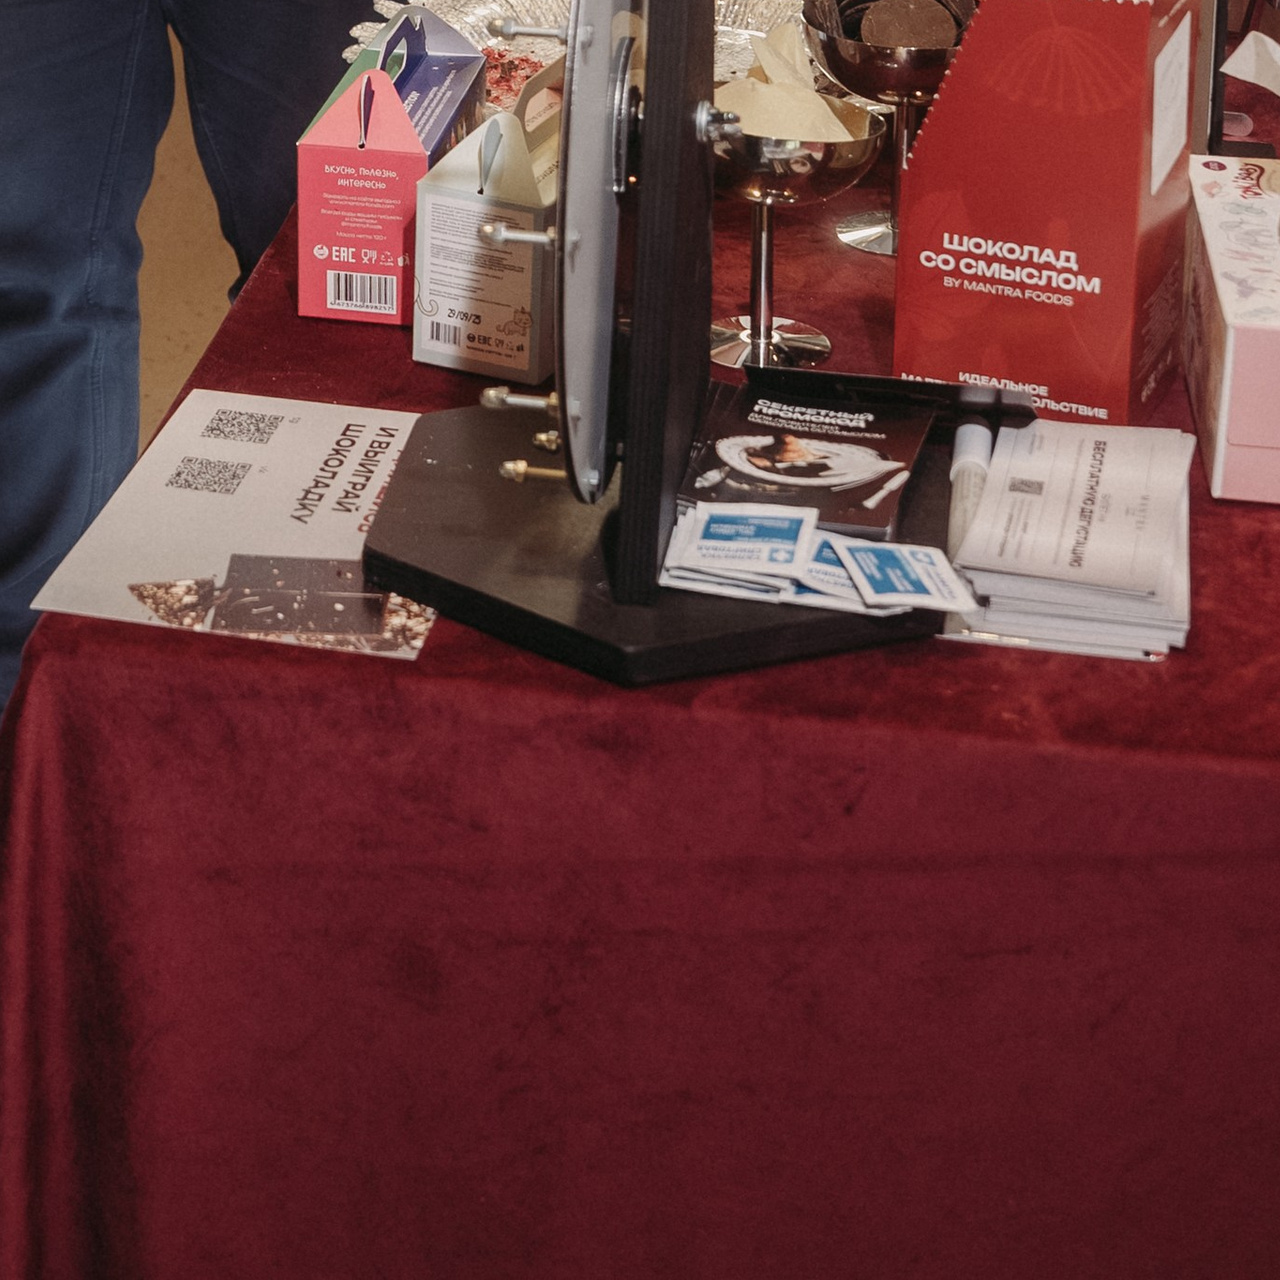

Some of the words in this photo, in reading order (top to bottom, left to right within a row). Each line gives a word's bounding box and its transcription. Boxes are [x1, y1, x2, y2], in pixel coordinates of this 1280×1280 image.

[332, 246, 356, 263] EAC
[943, 232, 1079, 271] ШОКОЛАД
[919, 250, 956, 271] СО
[959, 258, 1101, 294] СМЫСЛОМ
[943, 276, 962, 288] BY
[963, 279, 1023, 299] MANTRA
[1024, 290, 1074, 307] FOODS
[958, 371, 1049, 397] ИДЕАЛЬНОЕ
[754, 404, 866, 428] ПРОМОКОД
[1031, 396, 1109, 420] ОЛЬСТВИЕ
[375, 426, 399, 438] И
[290, 423, 367, 524] ШОКОЛАДКУ
[331, 440, 391, 514] ВЫИГРАЙ
